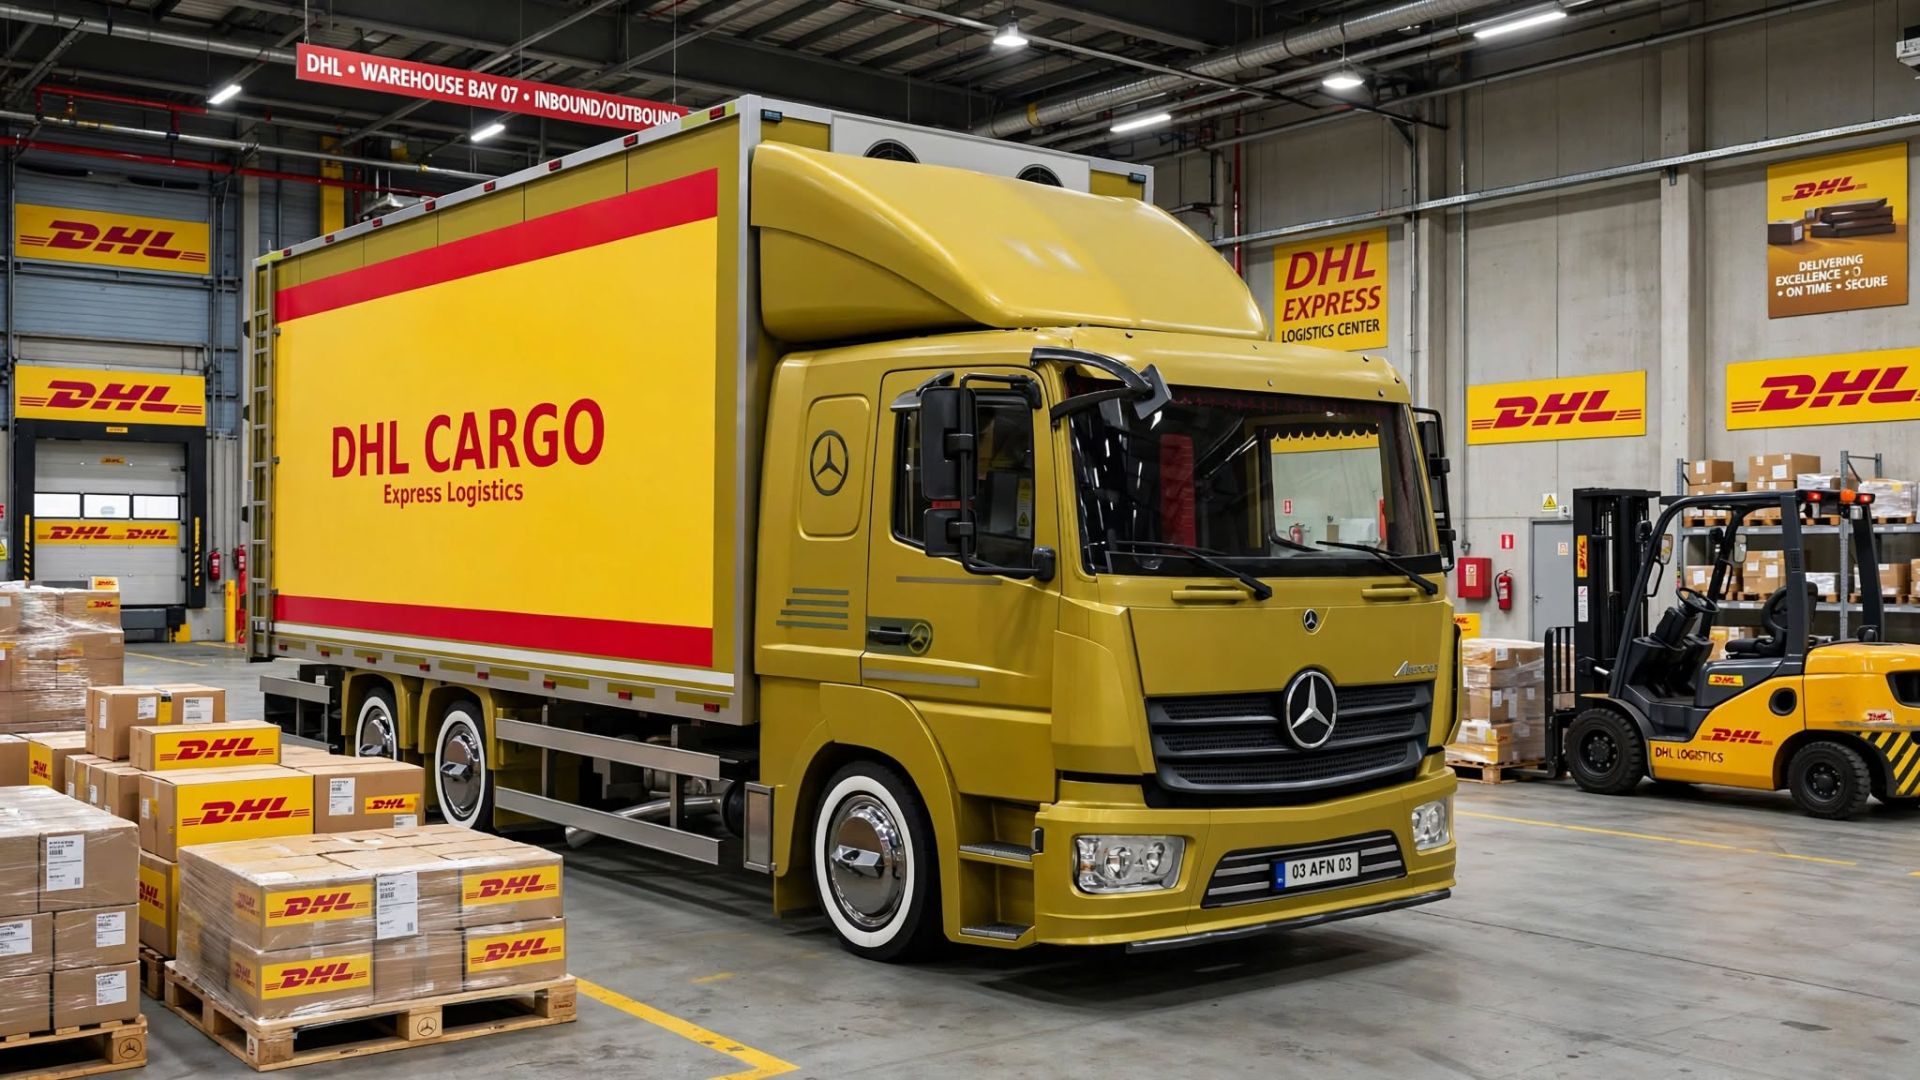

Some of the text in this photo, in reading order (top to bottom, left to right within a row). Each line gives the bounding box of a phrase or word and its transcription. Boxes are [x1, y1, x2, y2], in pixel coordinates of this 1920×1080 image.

[306, 53, 342, 77] DHL
[361, 61, 464, 95] WAREHOUSE
[468, 80, 497, 99] BAY
[500, 85, 518, 104] 07
[1792, 176, 1857, 200] DHL
[47, 220, 182, 259] DHL
[1285, 241, 1376, 291] DHL
[1799, 255, 1864, 271] DELIVERING
[1776, 269, 1841, 286] EXCELLENCE
[1786, 275, 1888, 298] ON TIME SECURE
[1282, 285, 1382, 322] EXPRESS
[1281, 318, 1380, 343] LOGISTICS CENTER
[46, 380, 178, 413] DHL
[1759, 366, 1918, 411] DHL
[1493, 389, 1617, 429] DHL
[332, 398, 604, 478] DHL CARGO
[384, 478, 524, 509] Express Logistics
[50, 526, 170, 540] DHL DHL
[1713, 676, 1736, 684] DHL
[176, 736, 259, 760] DHL
[1711, 727, 1763, 745] DHL
[1655, 747, 1724, 763] DHL LOGISTICS
[200, 796, 292, 825] DHL
[371, 798, 406, 810] DHL
[1292, 857, 1352, 879] 03 AFN 03
[479, 874, 545, 898] DHL
[284, 892, 355, 917] DHL
[484, 937, 550, 962] DHL
[280, 962, 354, 989] DHL
